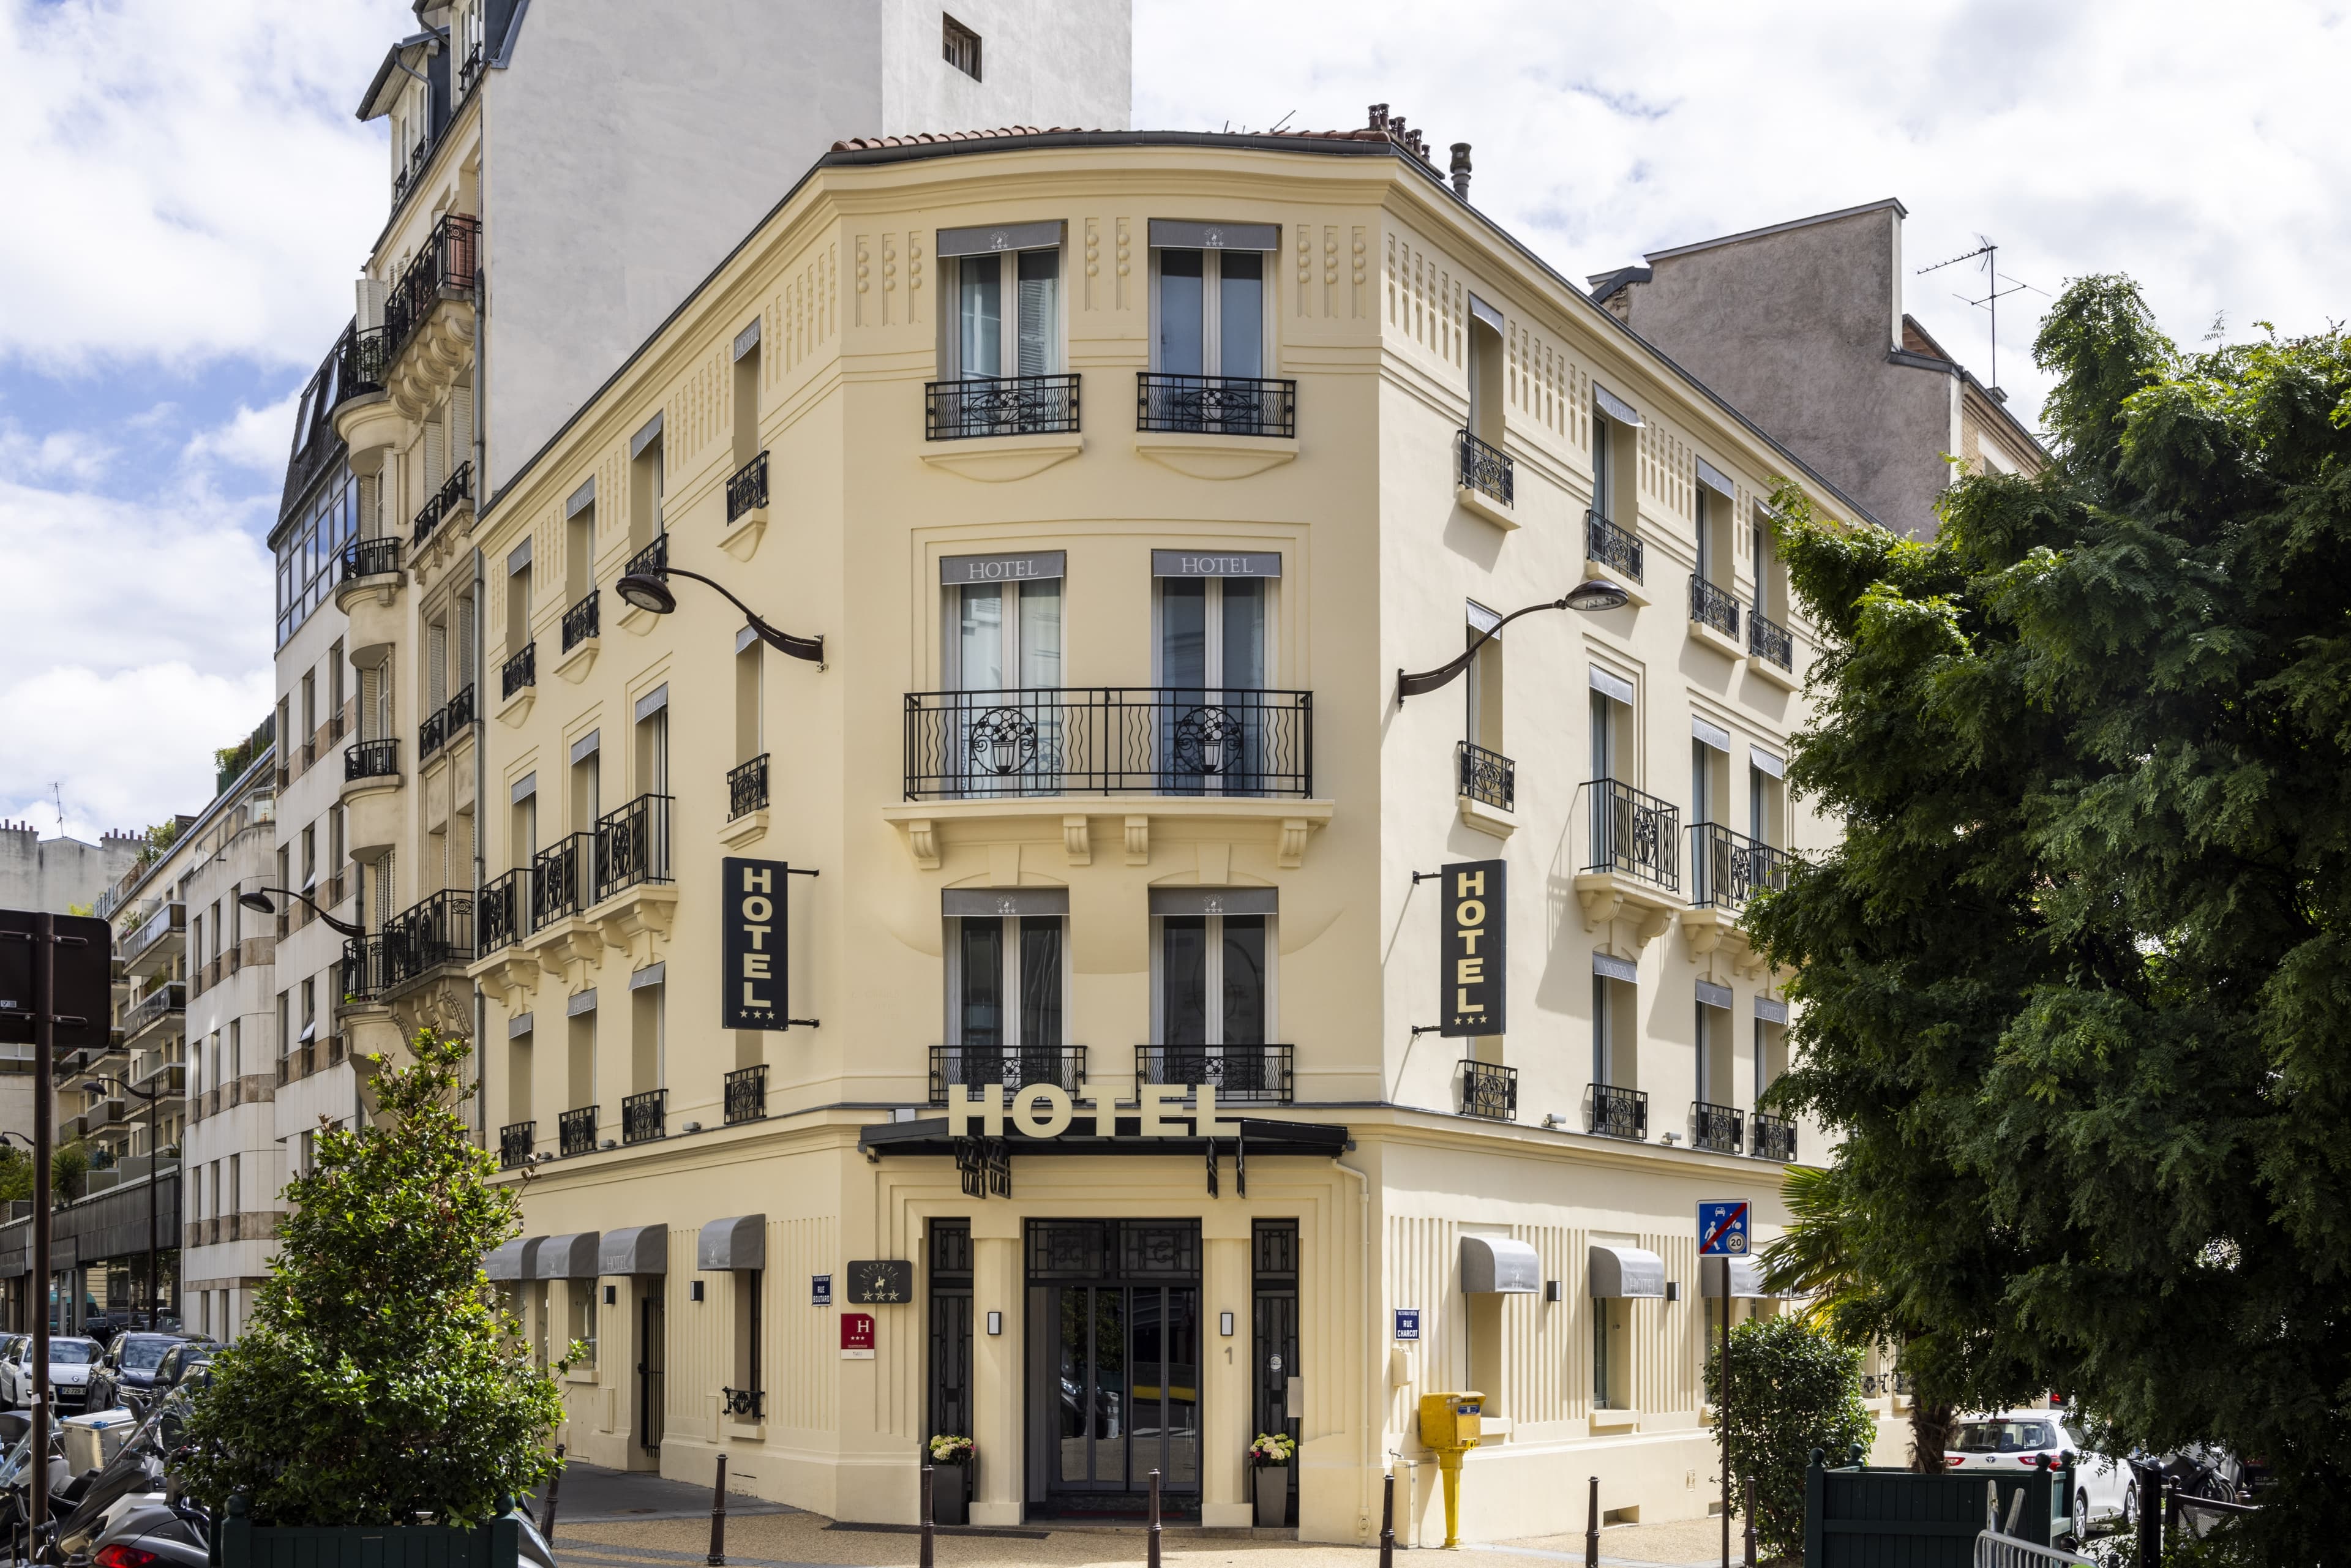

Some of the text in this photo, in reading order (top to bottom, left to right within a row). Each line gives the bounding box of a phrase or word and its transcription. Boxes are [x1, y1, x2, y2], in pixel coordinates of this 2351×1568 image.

[736, 326, 759, 357] HOTEL
[1602, 396, 1630, 422] HOTEL
[573, 488, 591, 512] HOTEL
[968, 560, 1038, 579] HOTEL
[1181, 557, 1254, 573] HOTEL
[642, 693, 661, 717] HOTEL
[516, 781, 531, 798] HOTEL
[741, 867, 773, 1008] HOTEL
[1457, 871, 1486, 1013] HOTEL
[1602, 961, 1631, 979] HOTEL
[573, 996, 592, 1012] HOTEL
[1761, 1003, 1780, 1021] HOTEL
[948, 1083, 1241, 1138] HOTEL
[607, 1255, 628, 1270] HOTEL
[860, 1263, 899, 1278] HOTEL
[1630, 1278, 1657, 1293] HOTEL
[857, 1320, 871, 1333] H
[1224, 1346, 1232, 1365] 1
